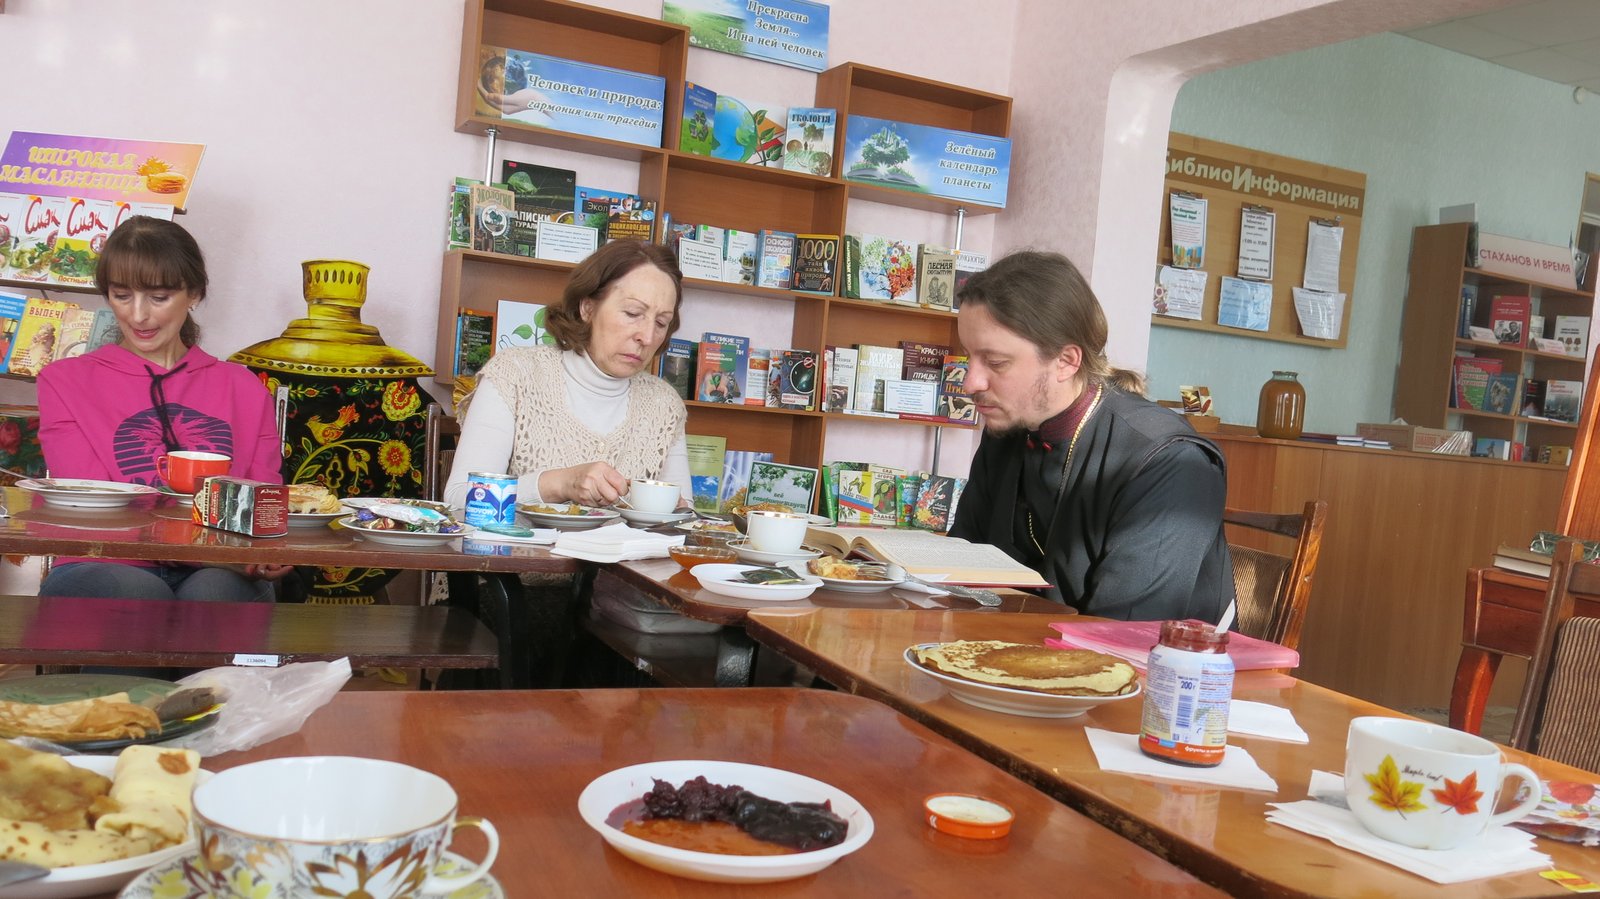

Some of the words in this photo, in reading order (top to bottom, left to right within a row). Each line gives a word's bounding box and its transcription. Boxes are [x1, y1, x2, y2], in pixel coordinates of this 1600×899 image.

[747, 0, 809, 24] Прекрасна
[755, 18, 800, 38] Земля...
[727, 27, 739, 39] И
[741, 34, 754, 43] на
[757, 37, 779, 49] ней
[781, 42, 824, 59] человек
[528, 74, 585, 96] Человек
[588, 88, 598, 98] и
[601, 91, 662, 110] природа:
[527, 100, 583, 117] гармония
[584, 108, 605, 121] или
[606, 113, 658, 129] трагедия
[28, 146, 138, 170] ШИРОКАЯ
[945, 140, 995, 159] Зелёный
[938, 160, 998, 177] календарь
[0, 165, 148, 196] МАСЛЕНИЦА
[943, 175, 991, 190] планеты
[25, 196, 61, 235] Смак
[587, 201, 608, 212] Экол
[66, 199, 109, 237] Смак
[512, 210, 551, 225] АПИСКИ
[515, 221, 538, 229] ТУРАЛ
[798, 240, 835, 260] 1000
[1480, 248, 1531, 266] СТАХАНОВ
[1534, 258, 1541, 267] И
[1543, 259, 1571, 273] ВРЕМЯ
[921, 347, 949, 356] КРАСНАЯ
[945, 382, 966, 394] Птиц
[1181, 681, 1192, 690] 200
